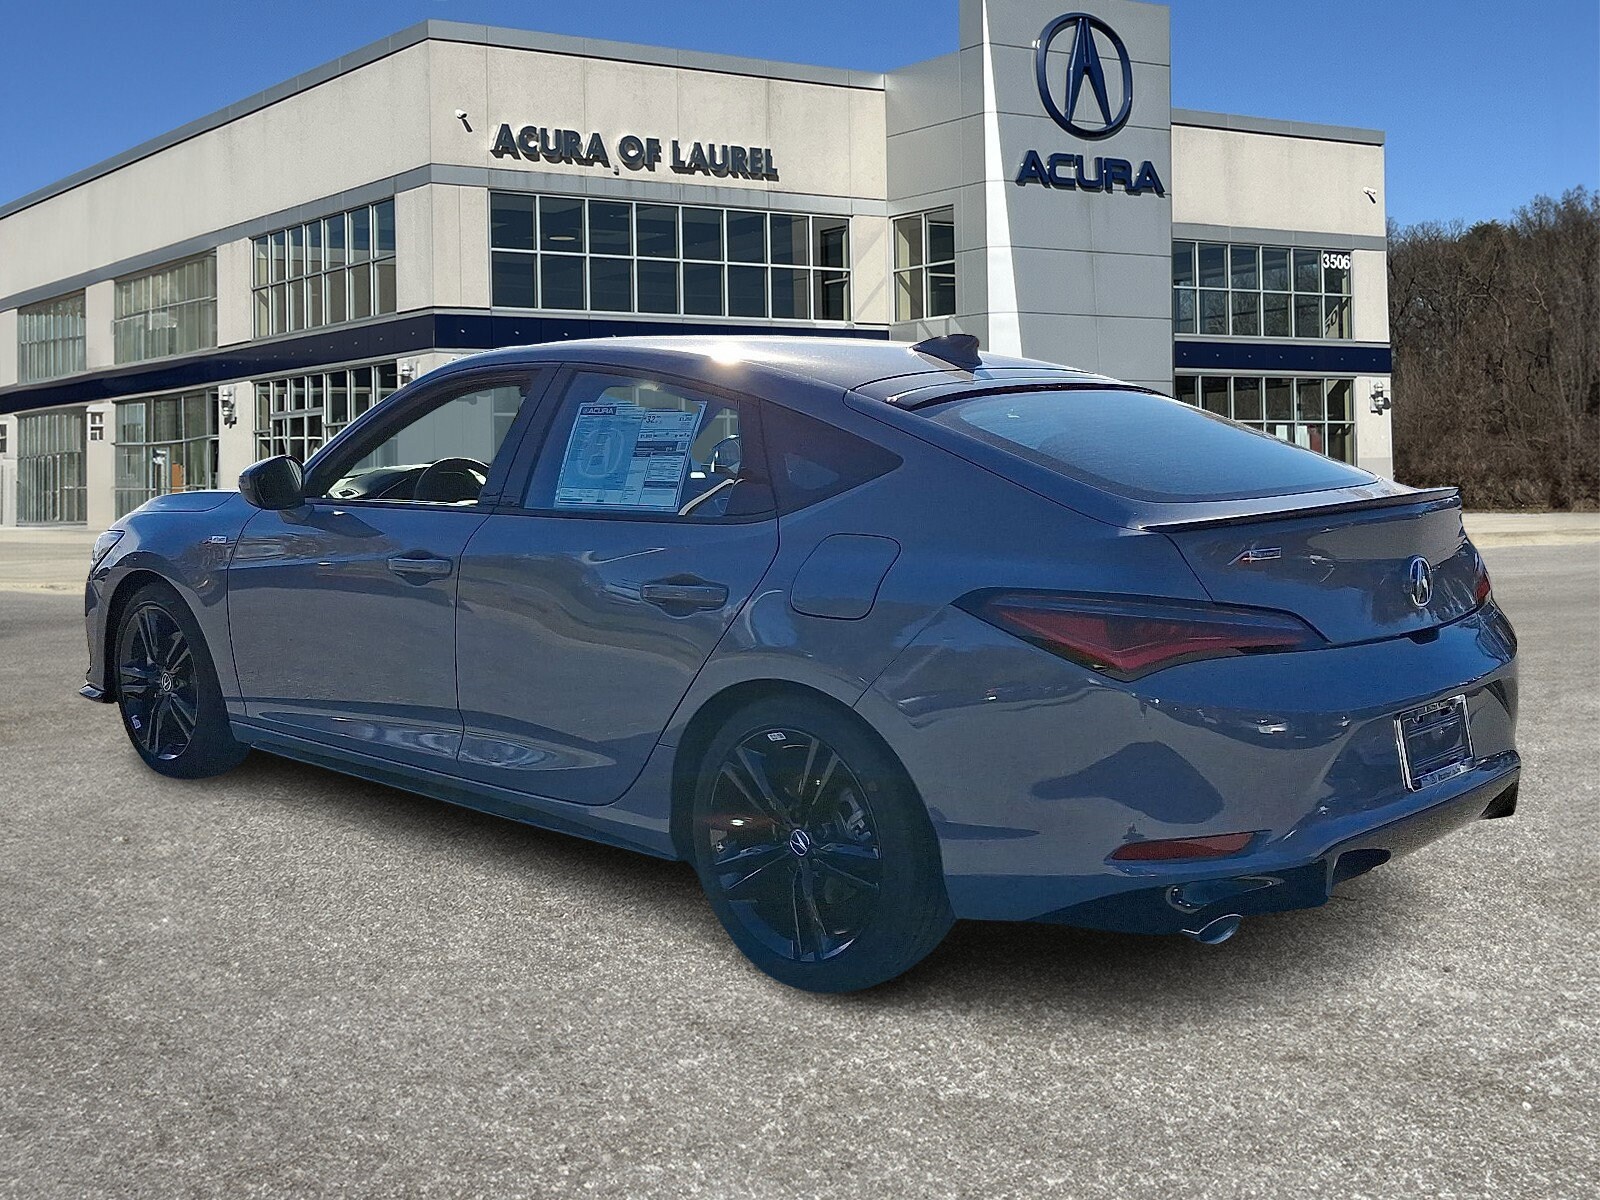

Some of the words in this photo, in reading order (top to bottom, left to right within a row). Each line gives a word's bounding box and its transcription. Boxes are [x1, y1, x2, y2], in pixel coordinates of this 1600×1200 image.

[491, 123, 610, 167] ACURA
[618, 135, 662, 171] OF
[670, 140, 779, 181] LAUREL
[1015, 150, 1166, 198] ACURA
[1322, 253, 1351, 270] 3506
[587, 406, 614, 414] ACURA
